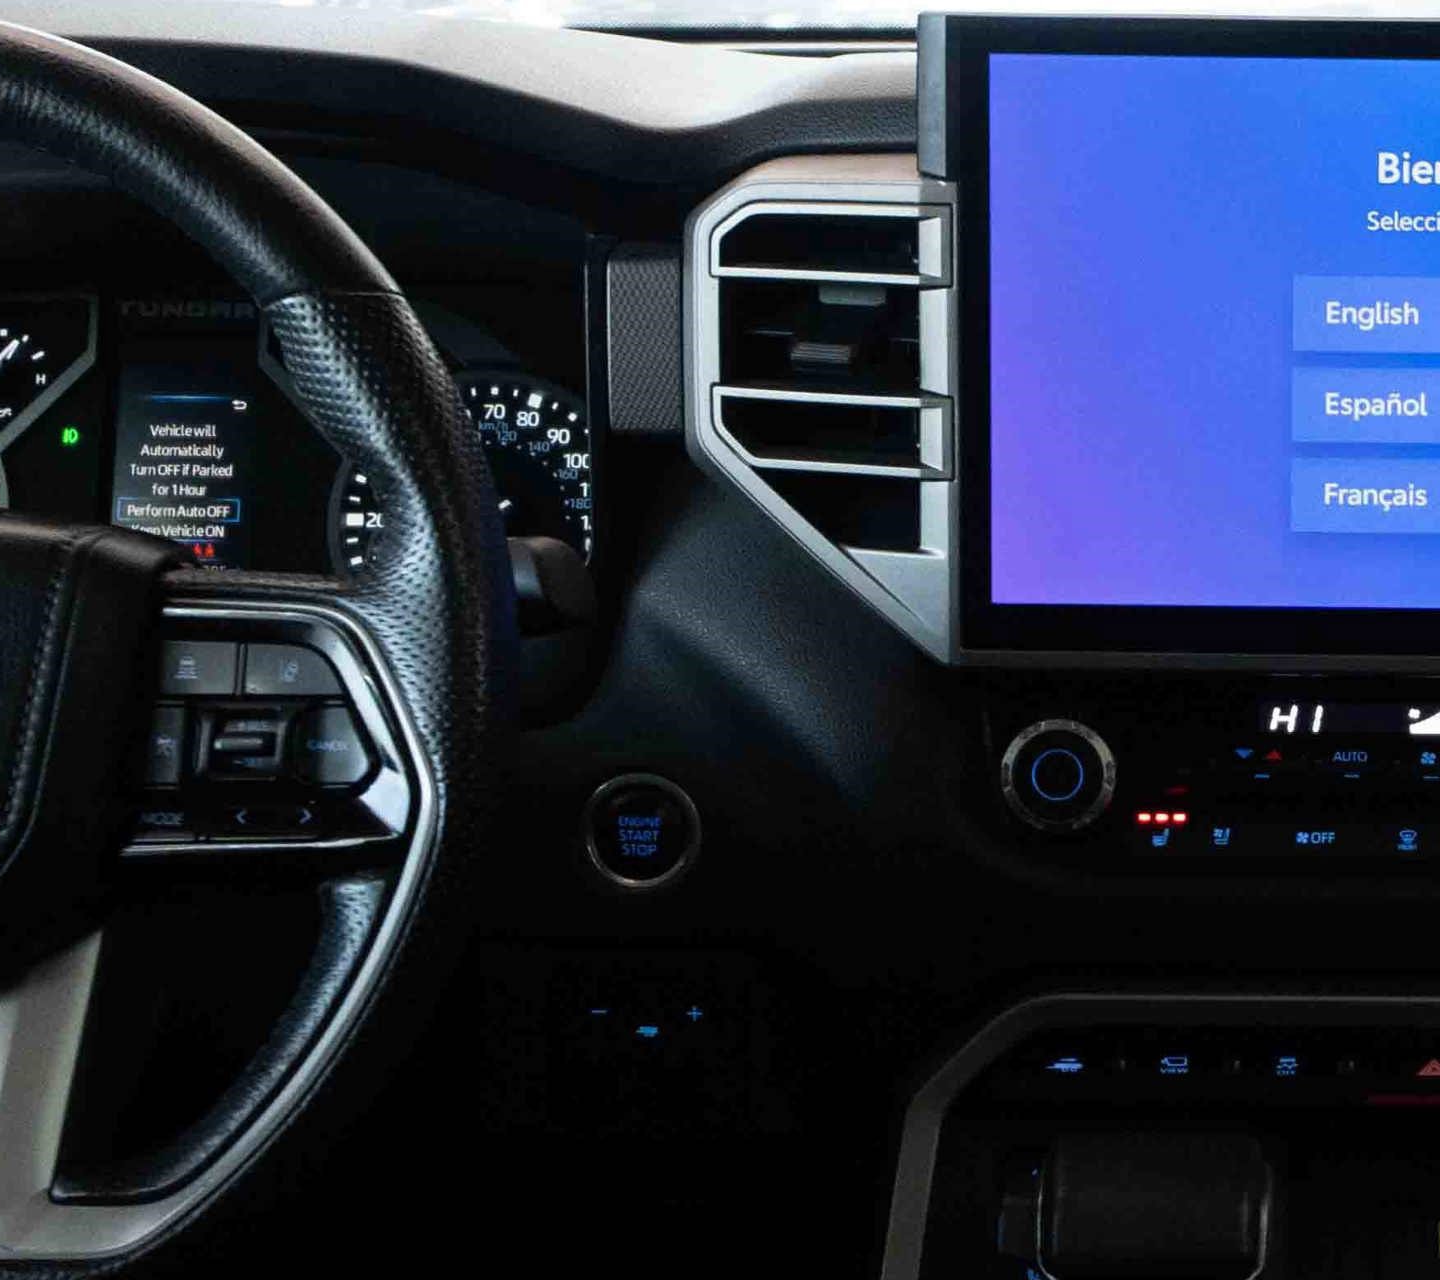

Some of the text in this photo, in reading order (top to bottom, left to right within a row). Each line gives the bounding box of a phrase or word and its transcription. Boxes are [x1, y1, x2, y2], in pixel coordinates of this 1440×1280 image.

[1325, 301, 1420, 331] English
[35, 372, 47, 385] H
[482, 403, 506, 420] 70
[1324, 391, 1428, 421] Español
[516, 411, 540, 428] 80
[150, 424, 217, 437] Vehicle will
[495, 430, 517, 442] 120
[547, 428, 571, 445] 90
[140, 444, 225, 459] Automatically
[528, 441, 550, 453] 140
[130, 463, 233, 477] Turn OFF if Parked
[152, 483, 208, 497] for 1 Hour
[1323, 482, 1429, 512] Français
[569, 498, 592, 510] 180
[127, 504, 231, 518] Perform Auto OFF
[161, 525, 204, 538] Vehicle
[205, 525, 225, 538] ON
[1333, 750, 1368, 763] AUTO
[618, 829, 661, 842] START
[1311, 832, 1336, 845] OFF
[620, 843, 657, 856] STOP
